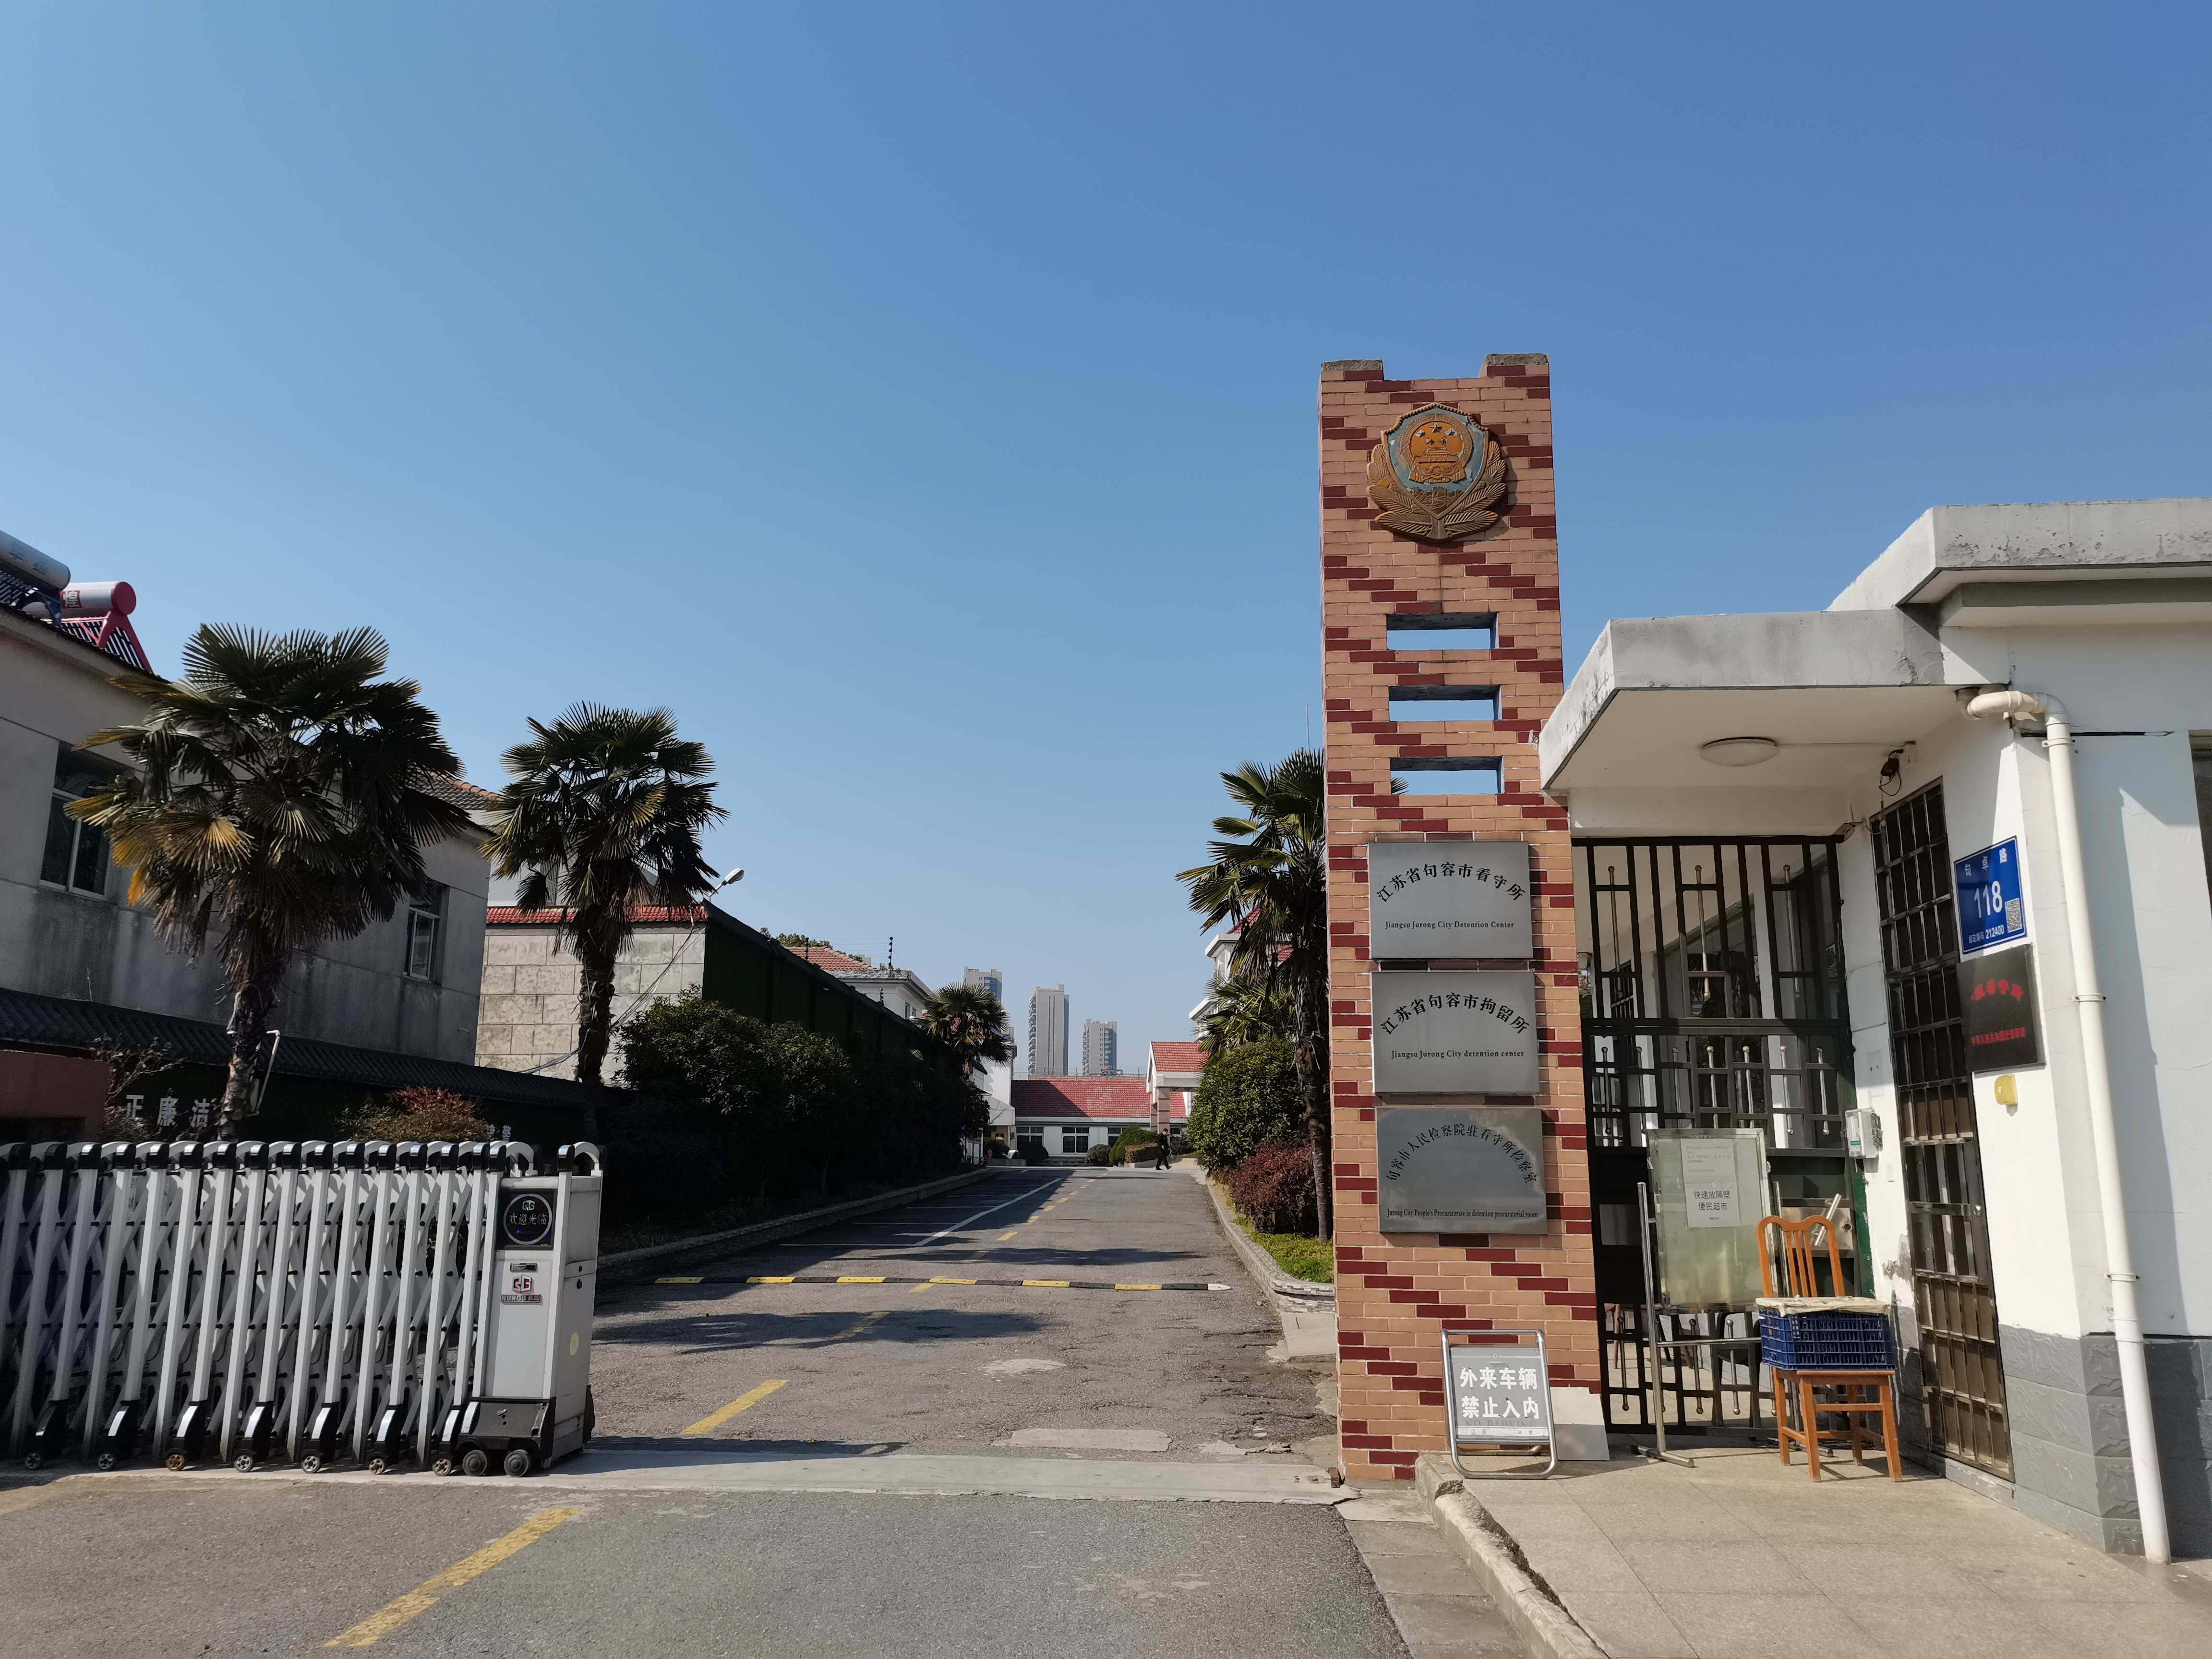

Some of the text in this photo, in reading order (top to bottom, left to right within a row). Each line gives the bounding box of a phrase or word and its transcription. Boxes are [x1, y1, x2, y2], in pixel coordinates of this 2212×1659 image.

[1376, 862, 1526, 902] 江苏省句容市看守所
[1974, 880, 2003, 919] 118
[1385, 921, 1410, 930] Jiangsu
[1412, 921, 1436, 930] Jurong
[1438, 921, 1452, 930] City
[1985, 924, 2005, 939] 212400
[1380, 992, 1530, 1034] 江苏省句容市拘留所
[1391, 1050, 1418, 1059] Jiangsu
[1419, 1050, 1444, 1059] Jurong
[1446, 1050, 1462, 1058] City
[1385, 1123, 1537, 1184] 句容市人民检察院驻看守所检察室
[1694, 1190, 1731, 1199] 快递放隔壁
[1404, 1208, 1413, 1218] City
[1414, 1208, 1433, 1218] People's
[1494, 1210, 1524, 1219] procuratorial
[1699, 1202, 1728, 1211] 便民超市
[508, 1213, 548, 1226] 欢迎光临
[1459, 1367, 1537, 1389] 外来车辆
[1461, 1396, 1539, 1419] 禁止入内
